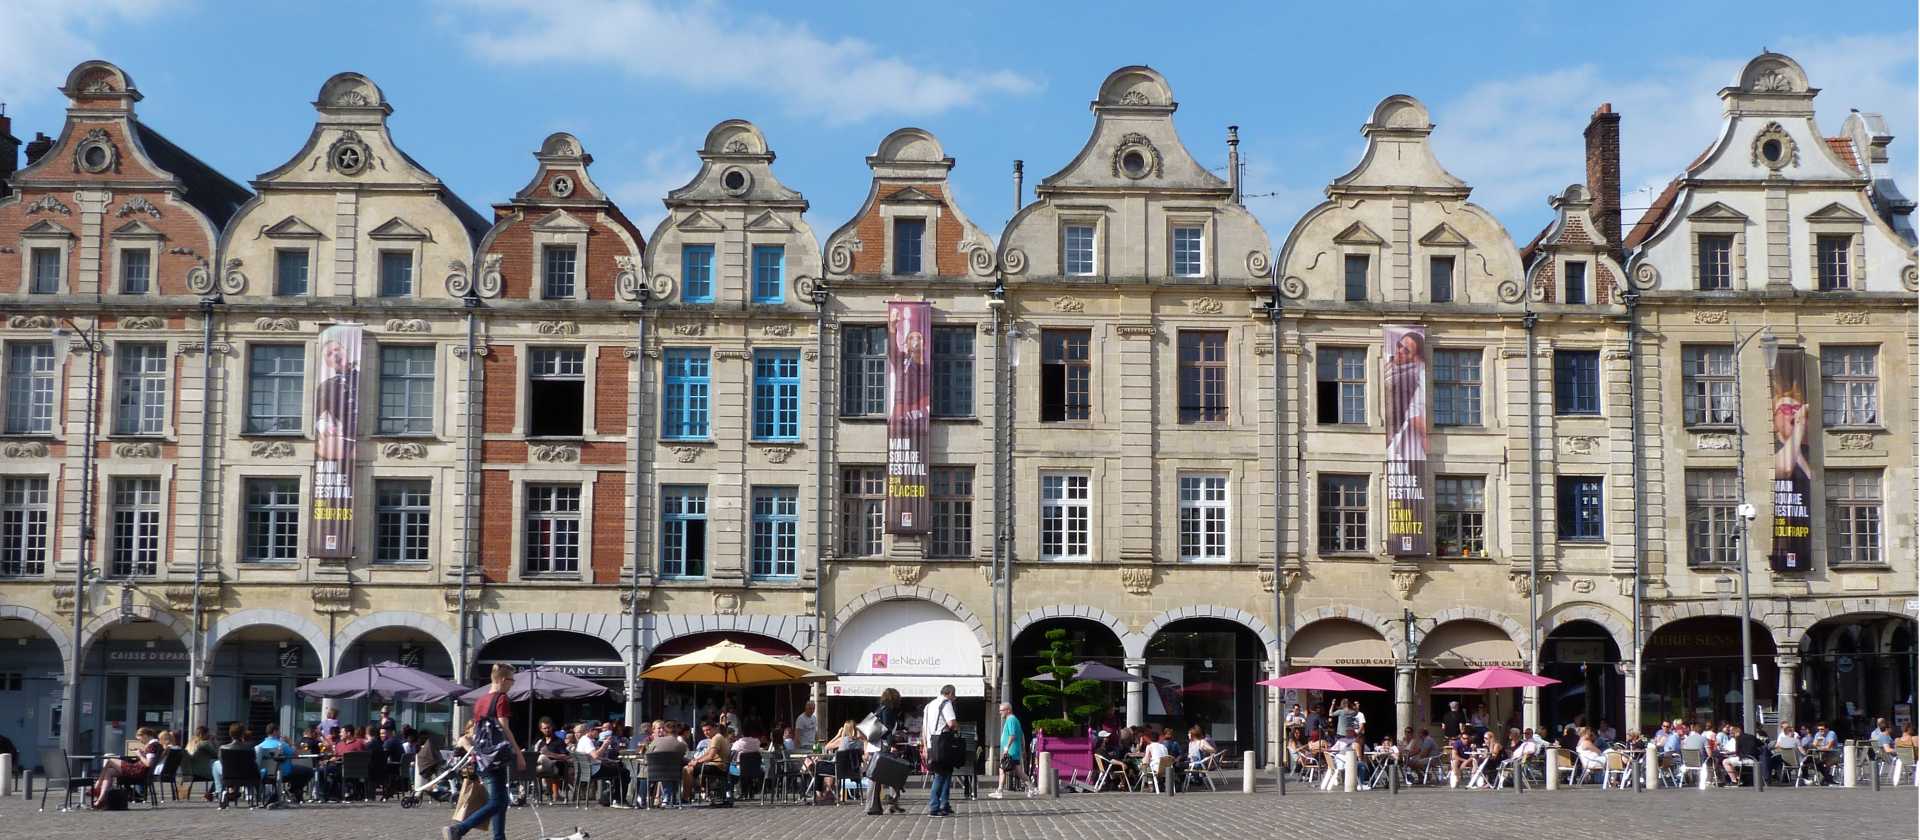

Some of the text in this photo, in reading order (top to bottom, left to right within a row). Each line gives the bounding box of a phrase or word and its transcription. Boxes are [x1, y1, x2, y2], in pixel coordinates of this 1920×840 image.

[889, 438, 910, 450] MAIN
[889, 451, 920, 462] SQUARE
[316, 461, 337, 472] MAIN
[889, 463, 927, 475] FESTIVAL
[1388, 463, 1409, 475] MAIN
[315, 474, 348, 486] SQUARE
[1388, 475, 1418, 487] SQUARE
[315, 486, 353, 498] FESTIVAL
[889, 485, 925, 498] PLACEBO
[1389, 488, 1425, 500] FESTIVAL
[1389, 522, 1423, 534] KRAVITZ
[111, 651, 147, 660] CAISSE
